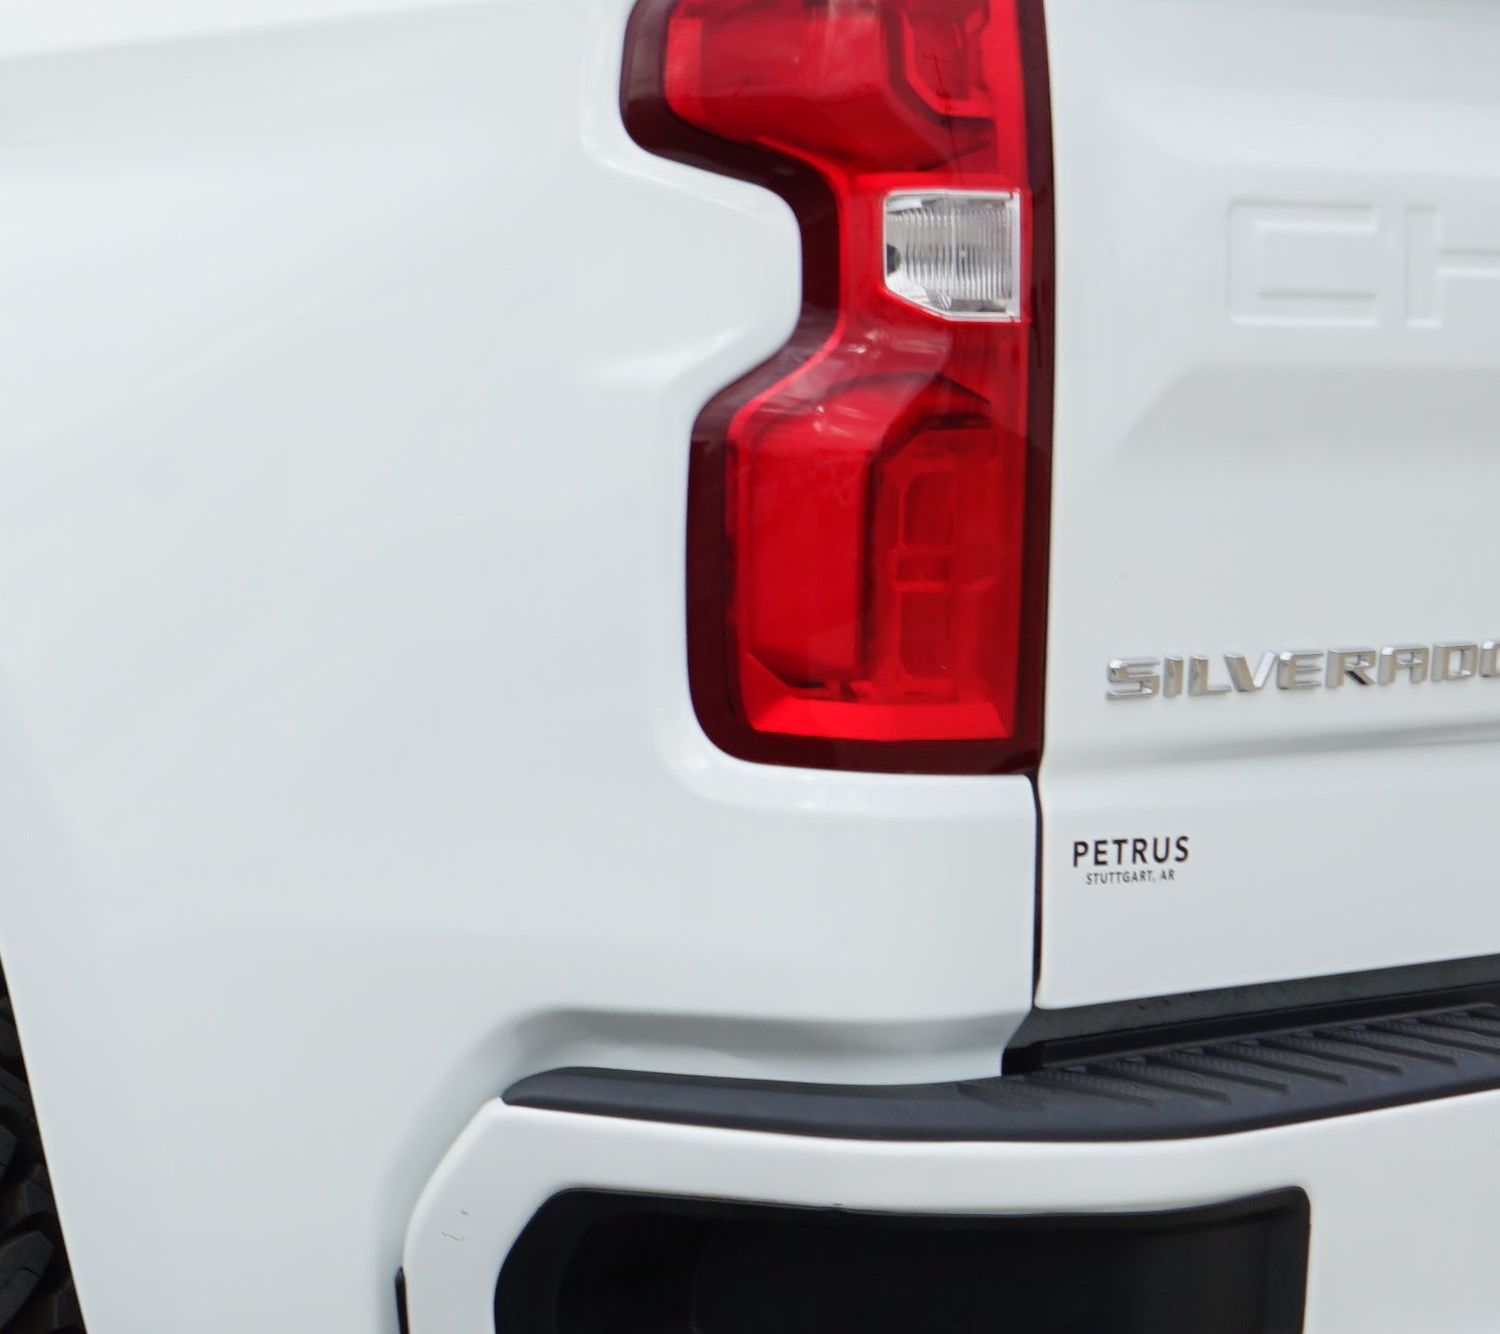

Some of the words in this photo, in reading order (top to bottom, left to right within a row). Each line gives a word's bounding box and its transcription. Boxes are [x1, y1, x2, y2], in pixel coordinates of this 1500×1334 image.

[1072, 835, 1190, 868] PETRUS
[1086, 869, 1157, 886] STUTTGART,
[1160, 868, 1176, 881] AR
